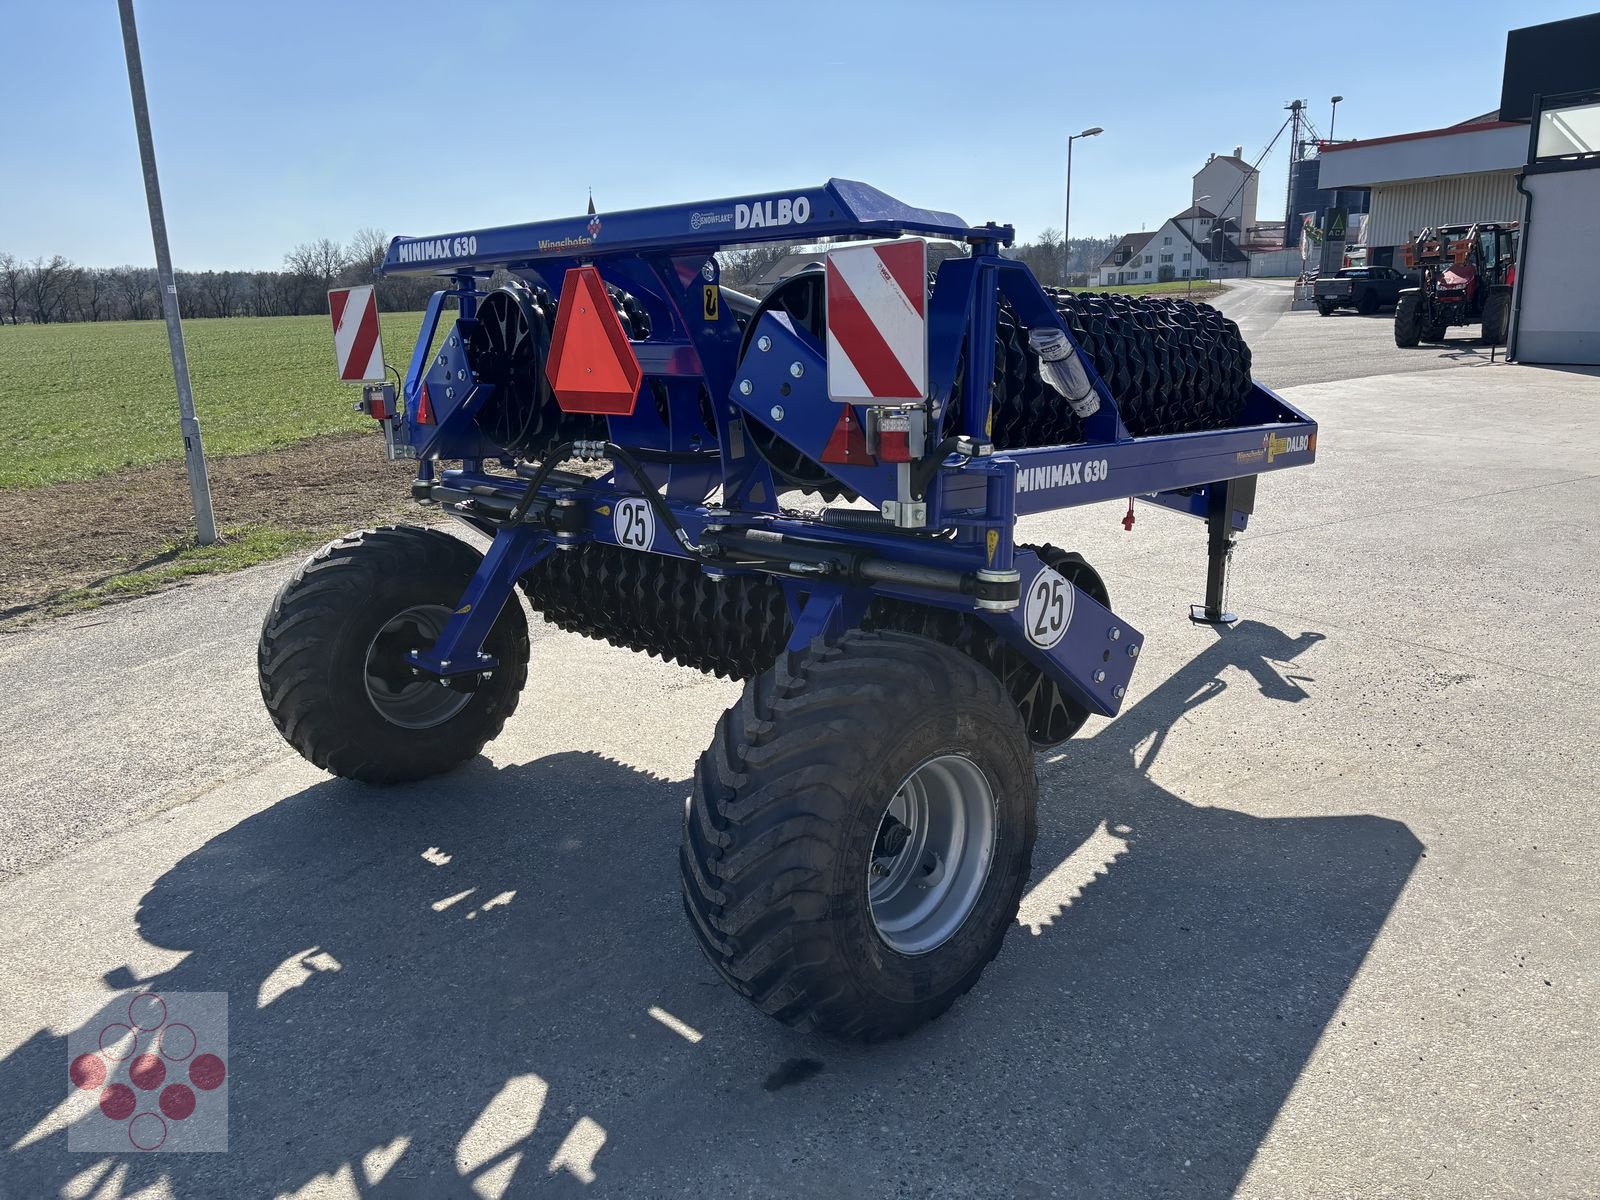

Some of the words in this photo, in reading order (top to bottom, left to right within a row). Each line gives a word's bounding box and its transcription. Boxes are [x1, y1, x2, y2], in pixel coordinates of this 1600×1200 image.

[735, 196, 810, 230] DALBO
[399, 238, 452, 263] MINIMAX
[453, 235, 477, 257] 630
[1286, 435, 1309, 453] DALBO
[1016, 462, 1082, 494] MINIMAX
[1084, 459, 1108, 483] 630
[622, 503, 646, 547] 25
[1034, 579, 1065, 636] 25
